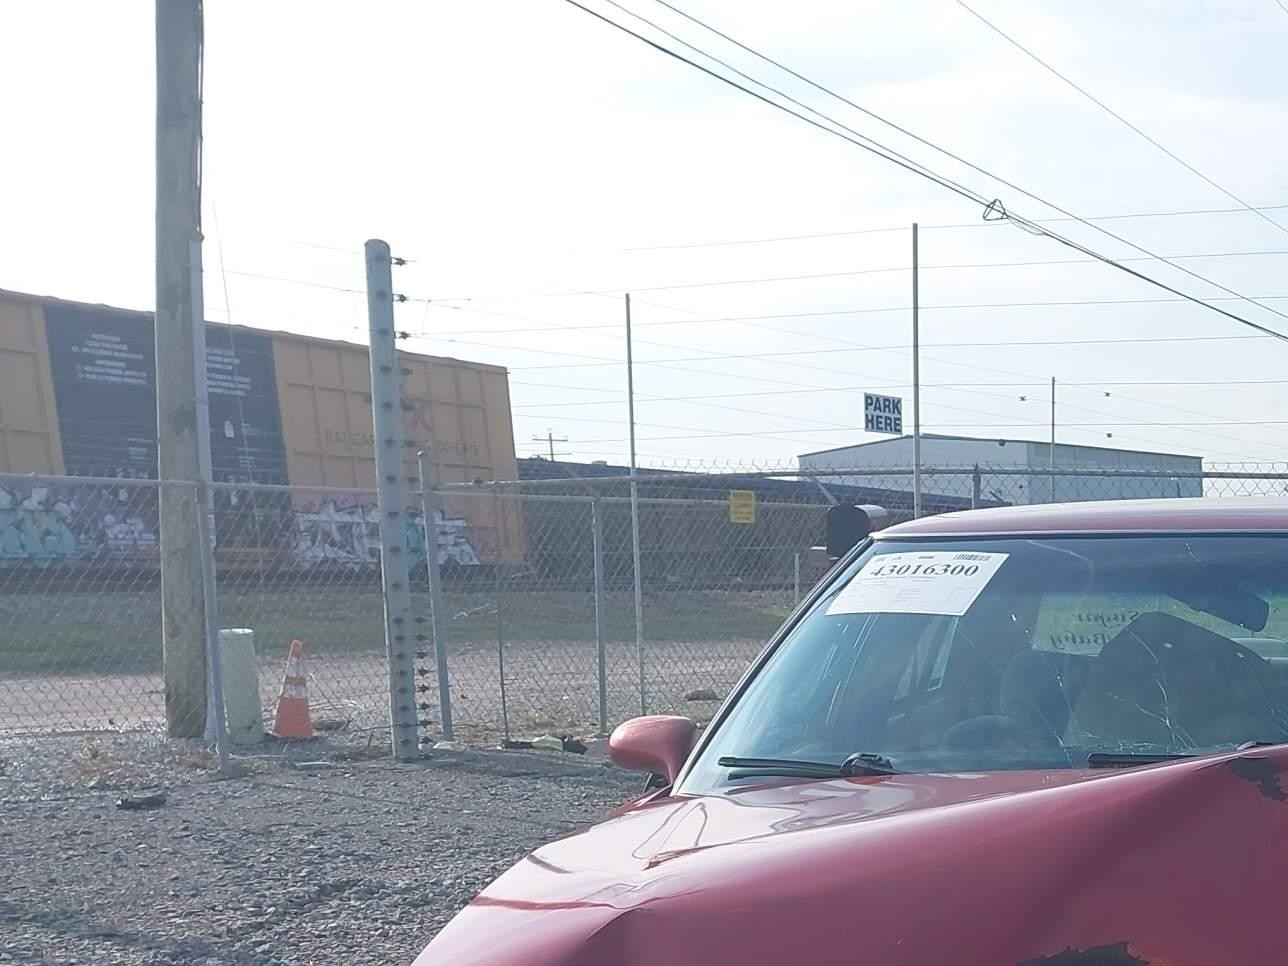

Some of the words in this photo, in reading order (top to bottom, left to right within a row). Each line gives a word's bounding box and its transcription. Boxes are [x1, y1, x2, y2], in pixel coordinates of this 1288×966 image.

[865, 395, 901, 415] PARK
[865, 414, 901, 432] HERE
[869, 563, 979, 577] 43016300
